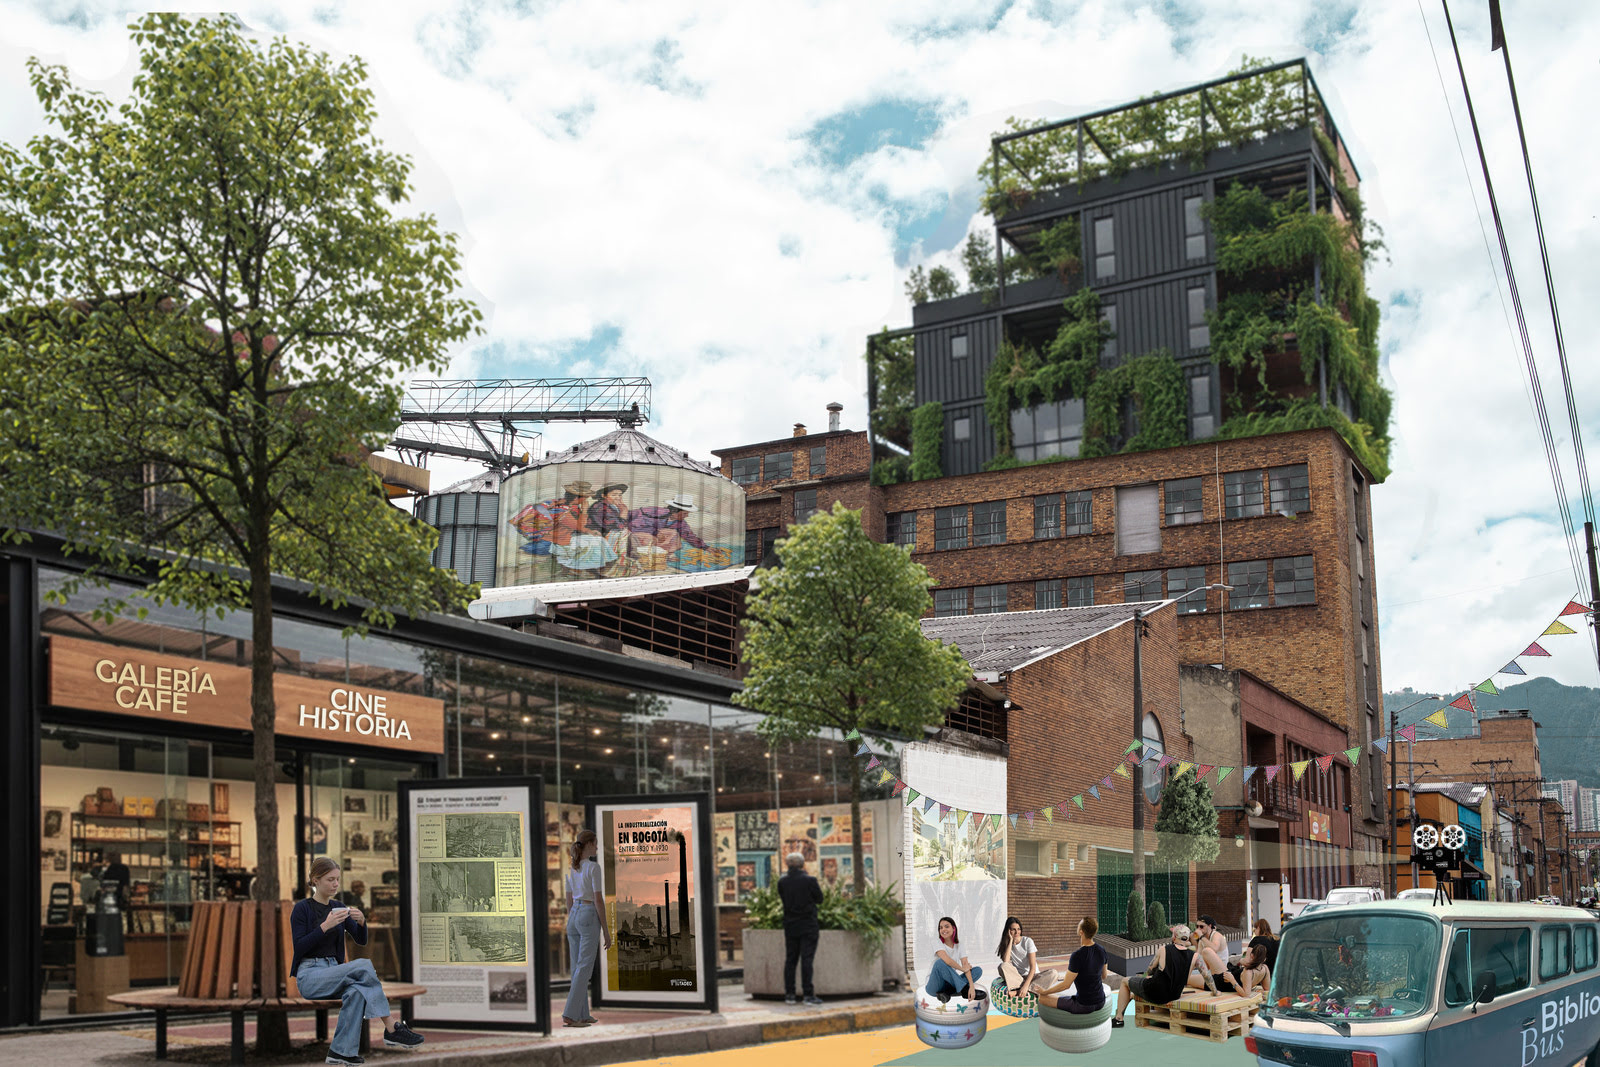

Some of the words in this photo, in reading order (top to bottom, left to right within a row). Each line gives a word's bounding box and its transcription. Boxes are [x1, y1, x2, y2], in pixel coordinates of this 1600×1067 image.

[95, 659, 217, 696] GALERÍA
[115, 683, 189, 714] CAFÉ
[330, 688, 388, 717] CINE
[298, 704, 413, 741] HISTORIA
[618, 832, 629, 843] EN
[632, 827, 668, 843] BOGOTÁ
[625, 820, 668, 828] INDUSTRIALIZACIÓN
[1541, 992, 1600, 1034] Biblio
[1519, 1027, 1565, 1067] Bus
